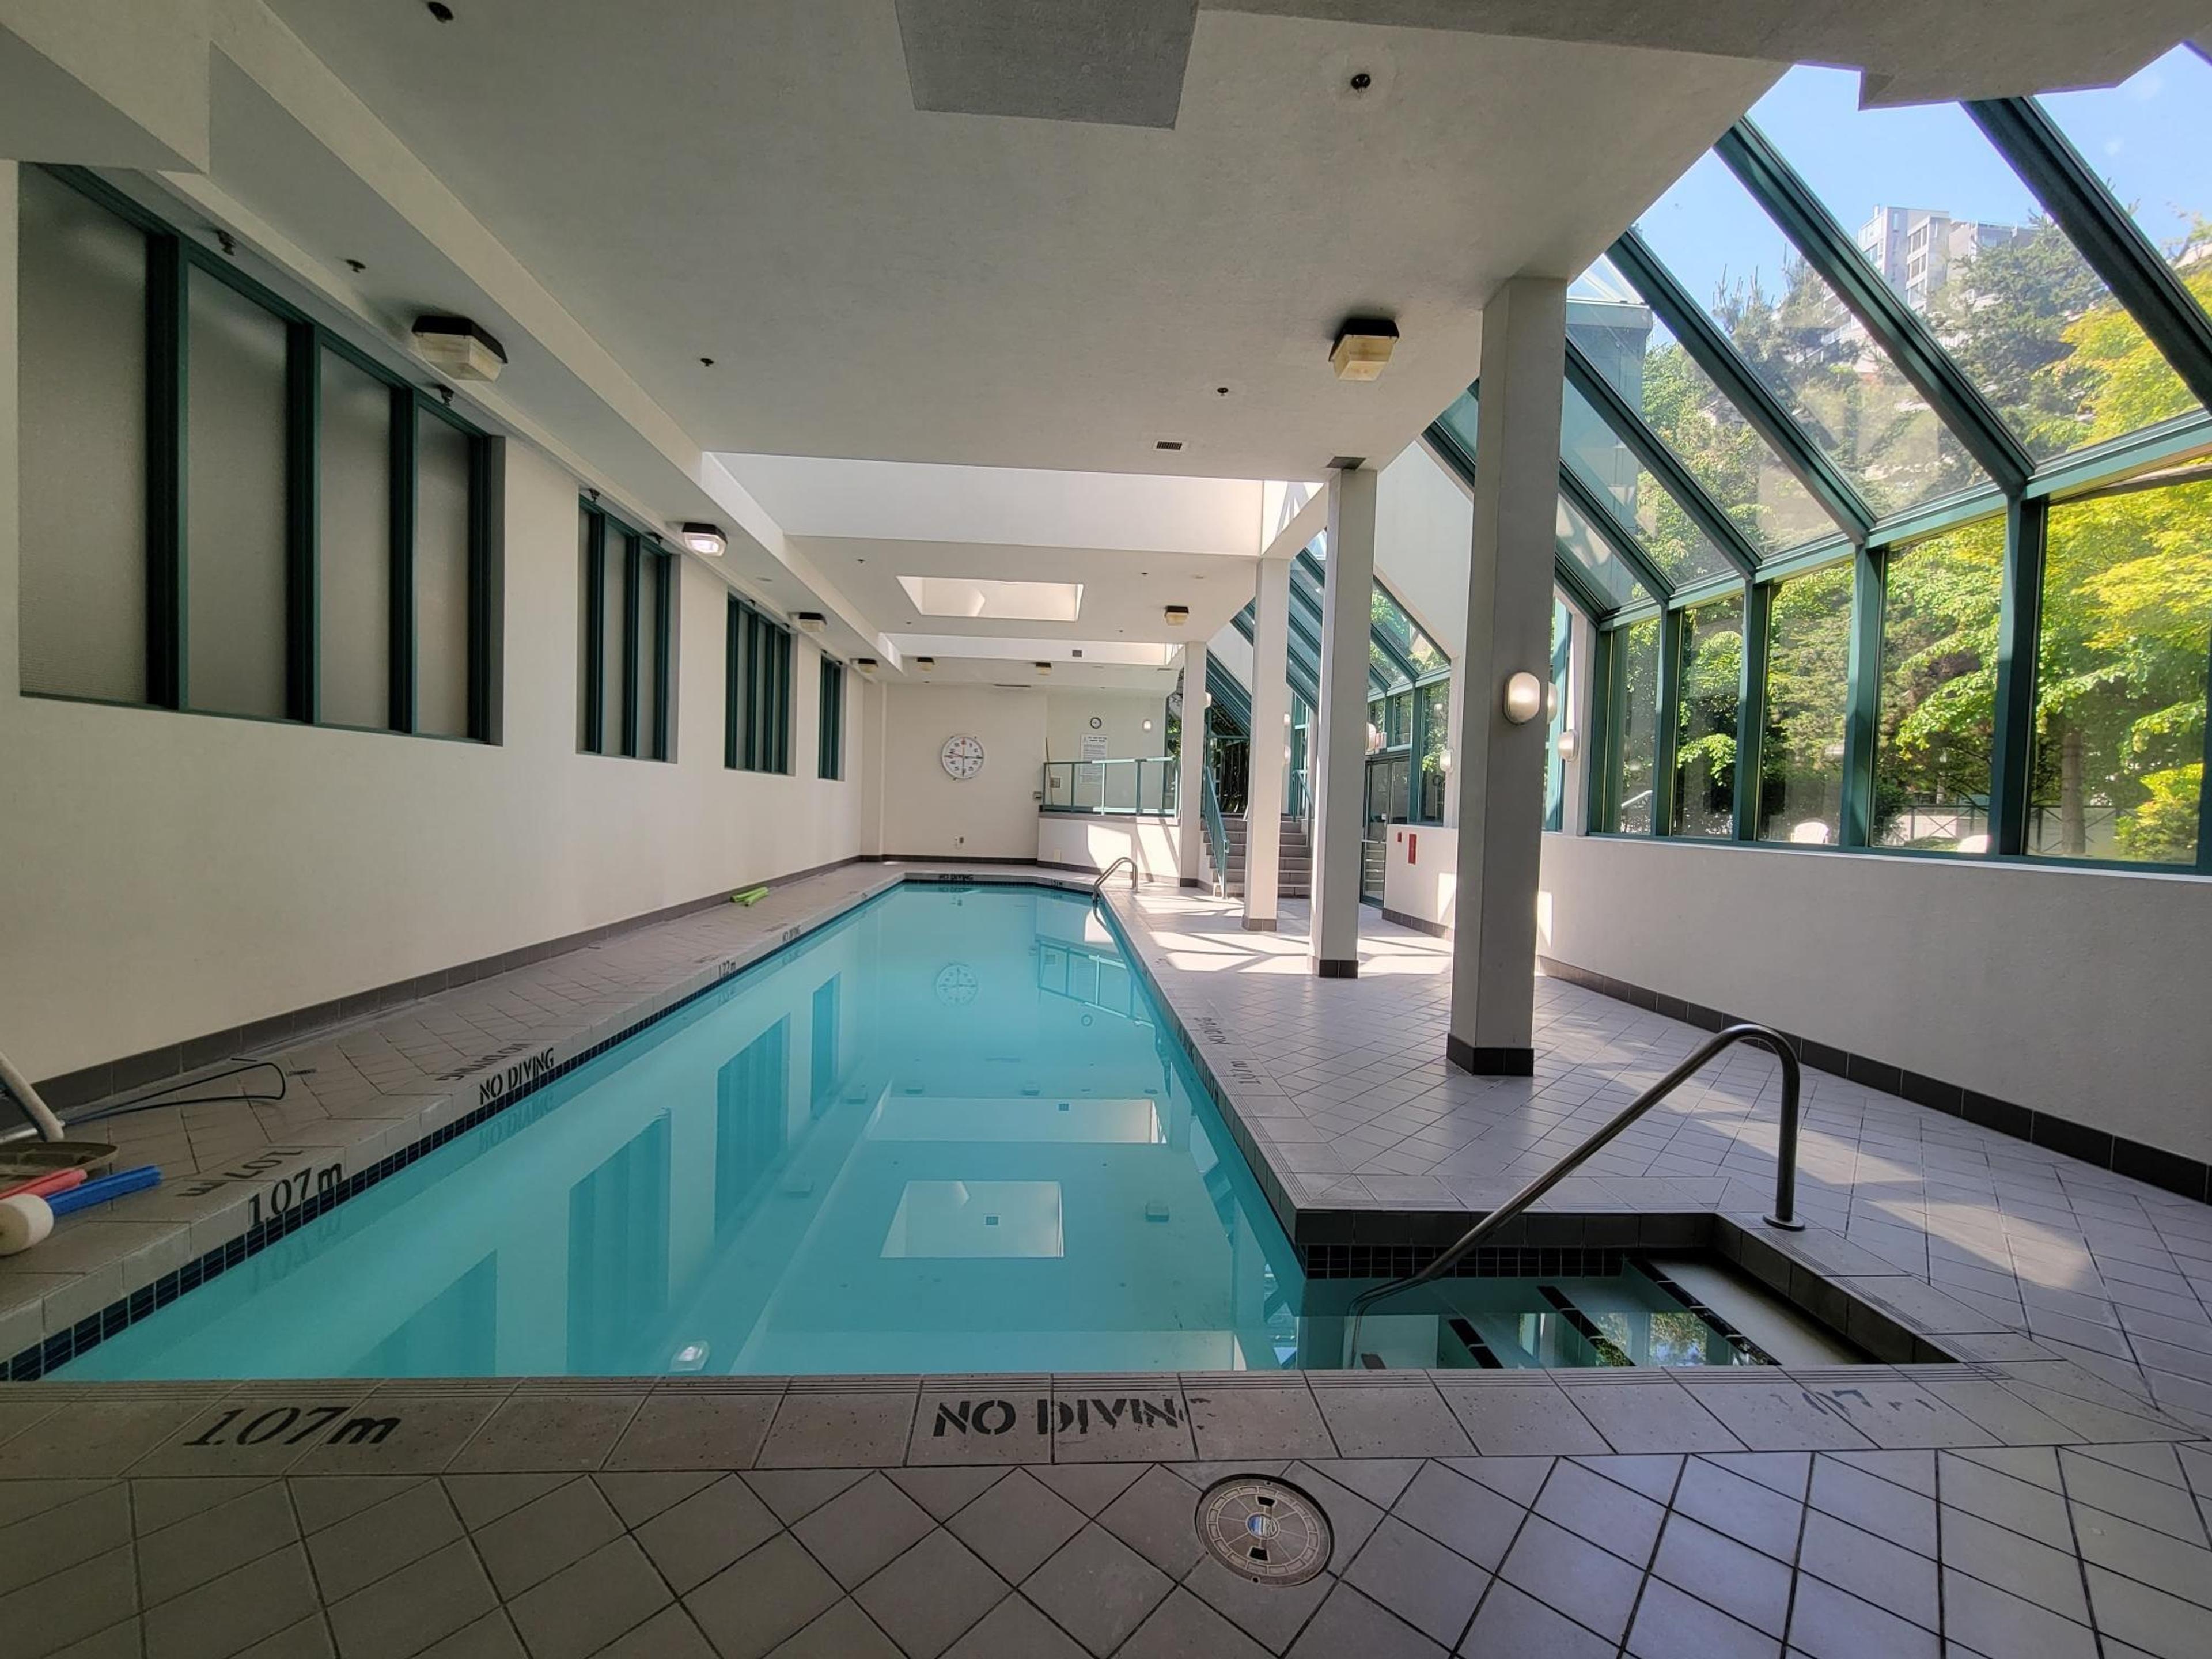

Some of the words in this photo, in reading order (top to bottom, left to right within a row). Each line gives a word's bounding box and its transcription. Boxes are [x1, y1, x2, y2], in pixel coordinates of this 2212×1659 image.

[480, 1074, 503, 1105] NO
[509, 1047, 554, 1090] DIVING
[248, 1163, 342, 1228] 1.07m
[182, 1406, 402, 1446] 1.07m
[933, 1400, 1016, 1437] NO
